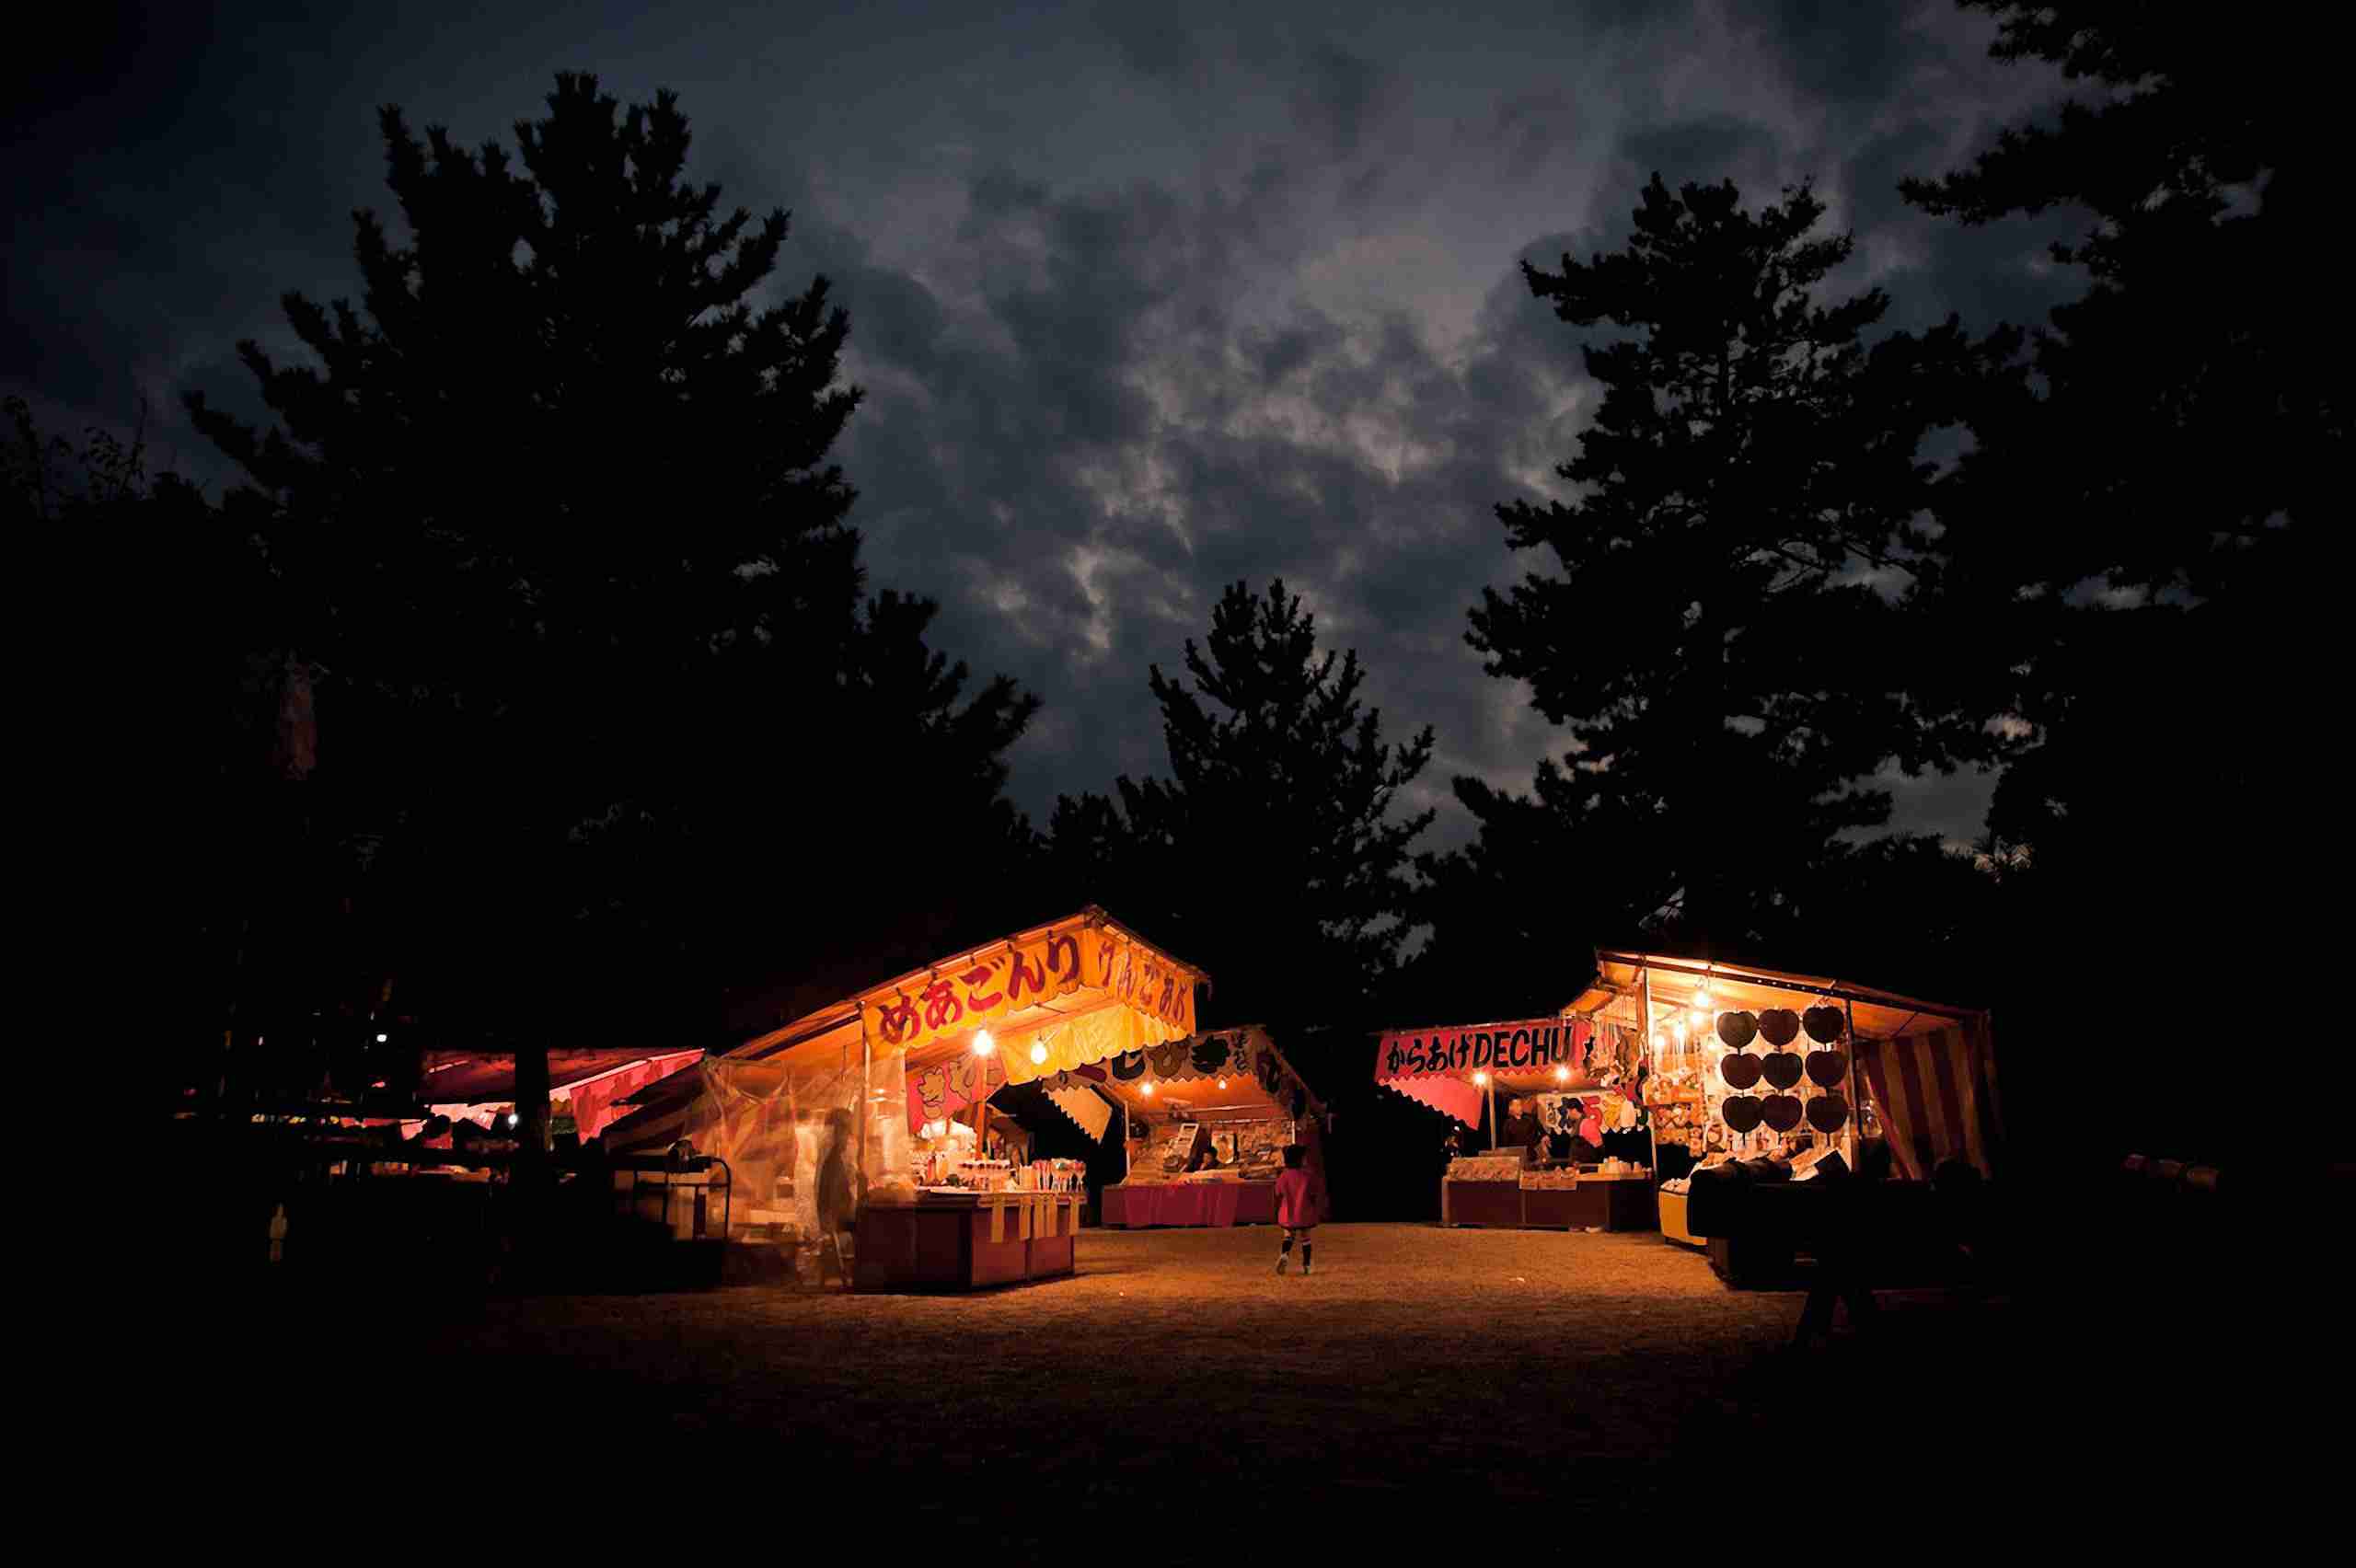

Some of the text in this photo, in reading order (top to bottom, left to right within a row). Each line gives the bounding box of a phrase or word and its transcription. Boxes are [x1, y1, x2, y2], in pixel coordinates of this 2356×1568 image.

[879, 930, 1080, 1043] めあごんり
